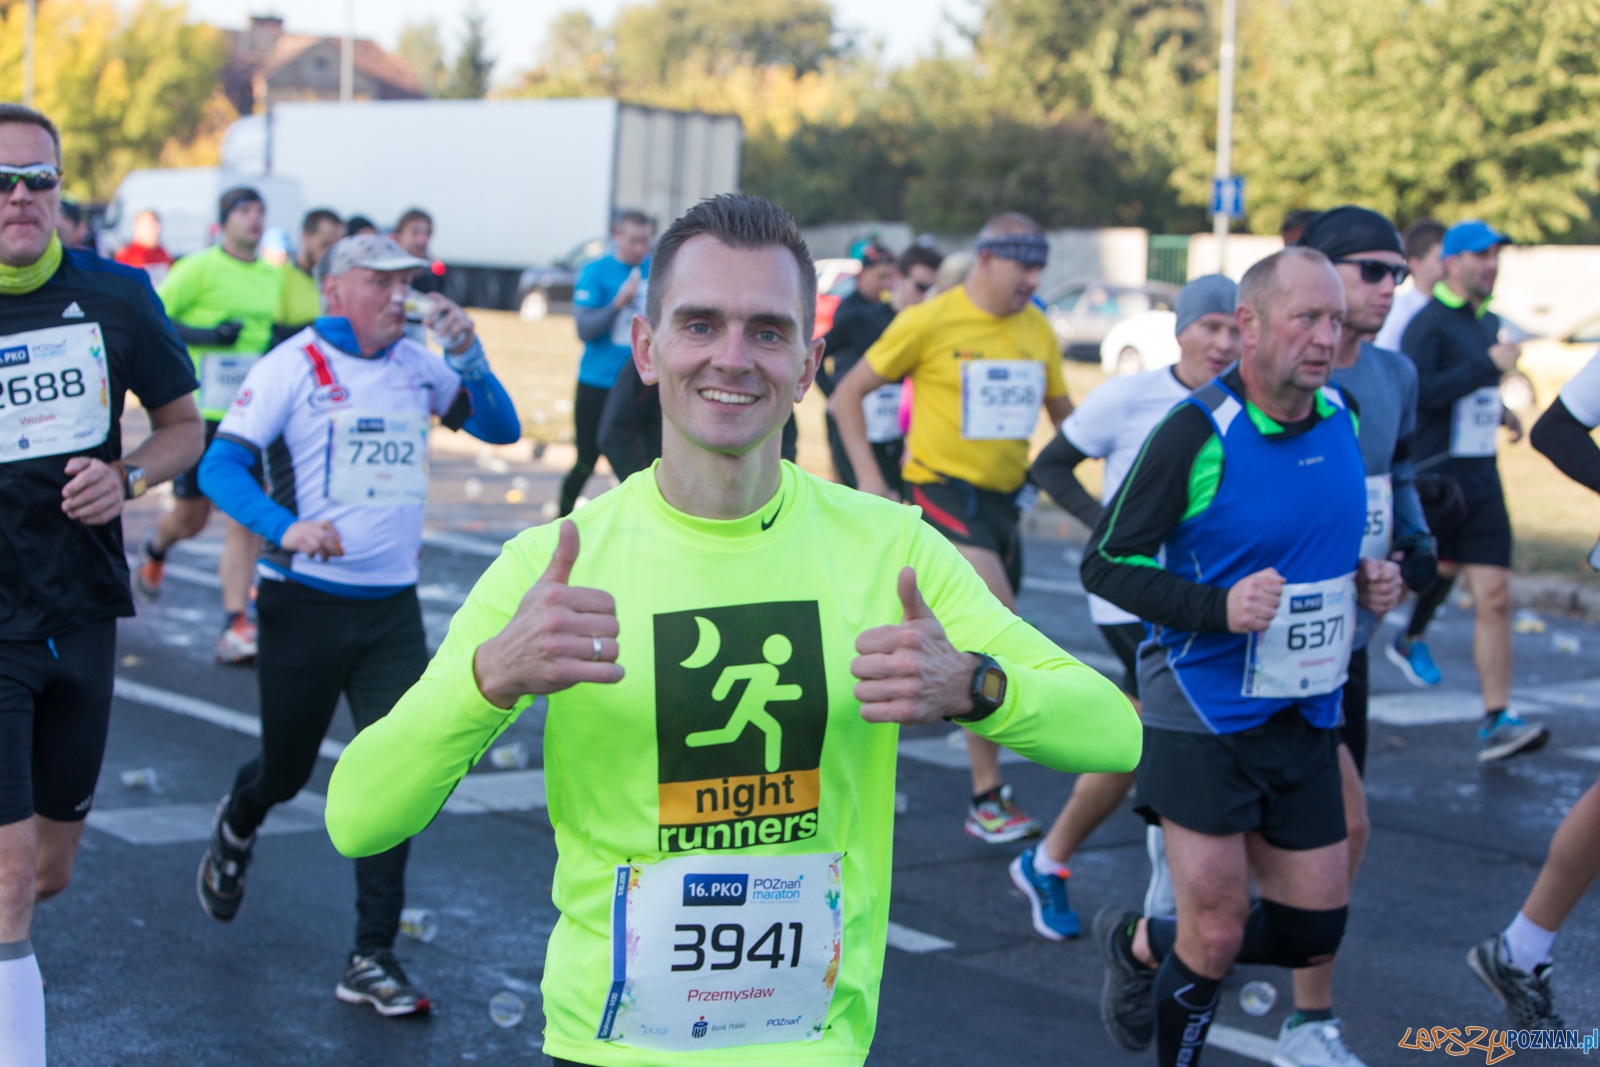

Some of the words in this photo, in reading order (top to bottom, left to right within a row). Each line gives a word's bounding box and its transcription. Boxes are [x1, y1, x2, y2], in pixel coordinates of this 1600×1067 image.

[4, 350, 27, 363] PKO
[0, 368, 86, 409] 688
[348, 440, 415, 465] 7202
[1288, 614, 1344, 651] 6371
[695, 774, 795, 817] night
[660, 812, 818, 851] runners
[688, 882, 709, 897] 16.
[711, 882, 743, 897] PKO
[752, 889, 801, 900] maraton
[671, 922, 803, 972] 3941
[687, 987, 775, 1003] Przemysław
[711, 1024, 727, 1032] Bank
[728, 1021, 746, 1031] Polski
